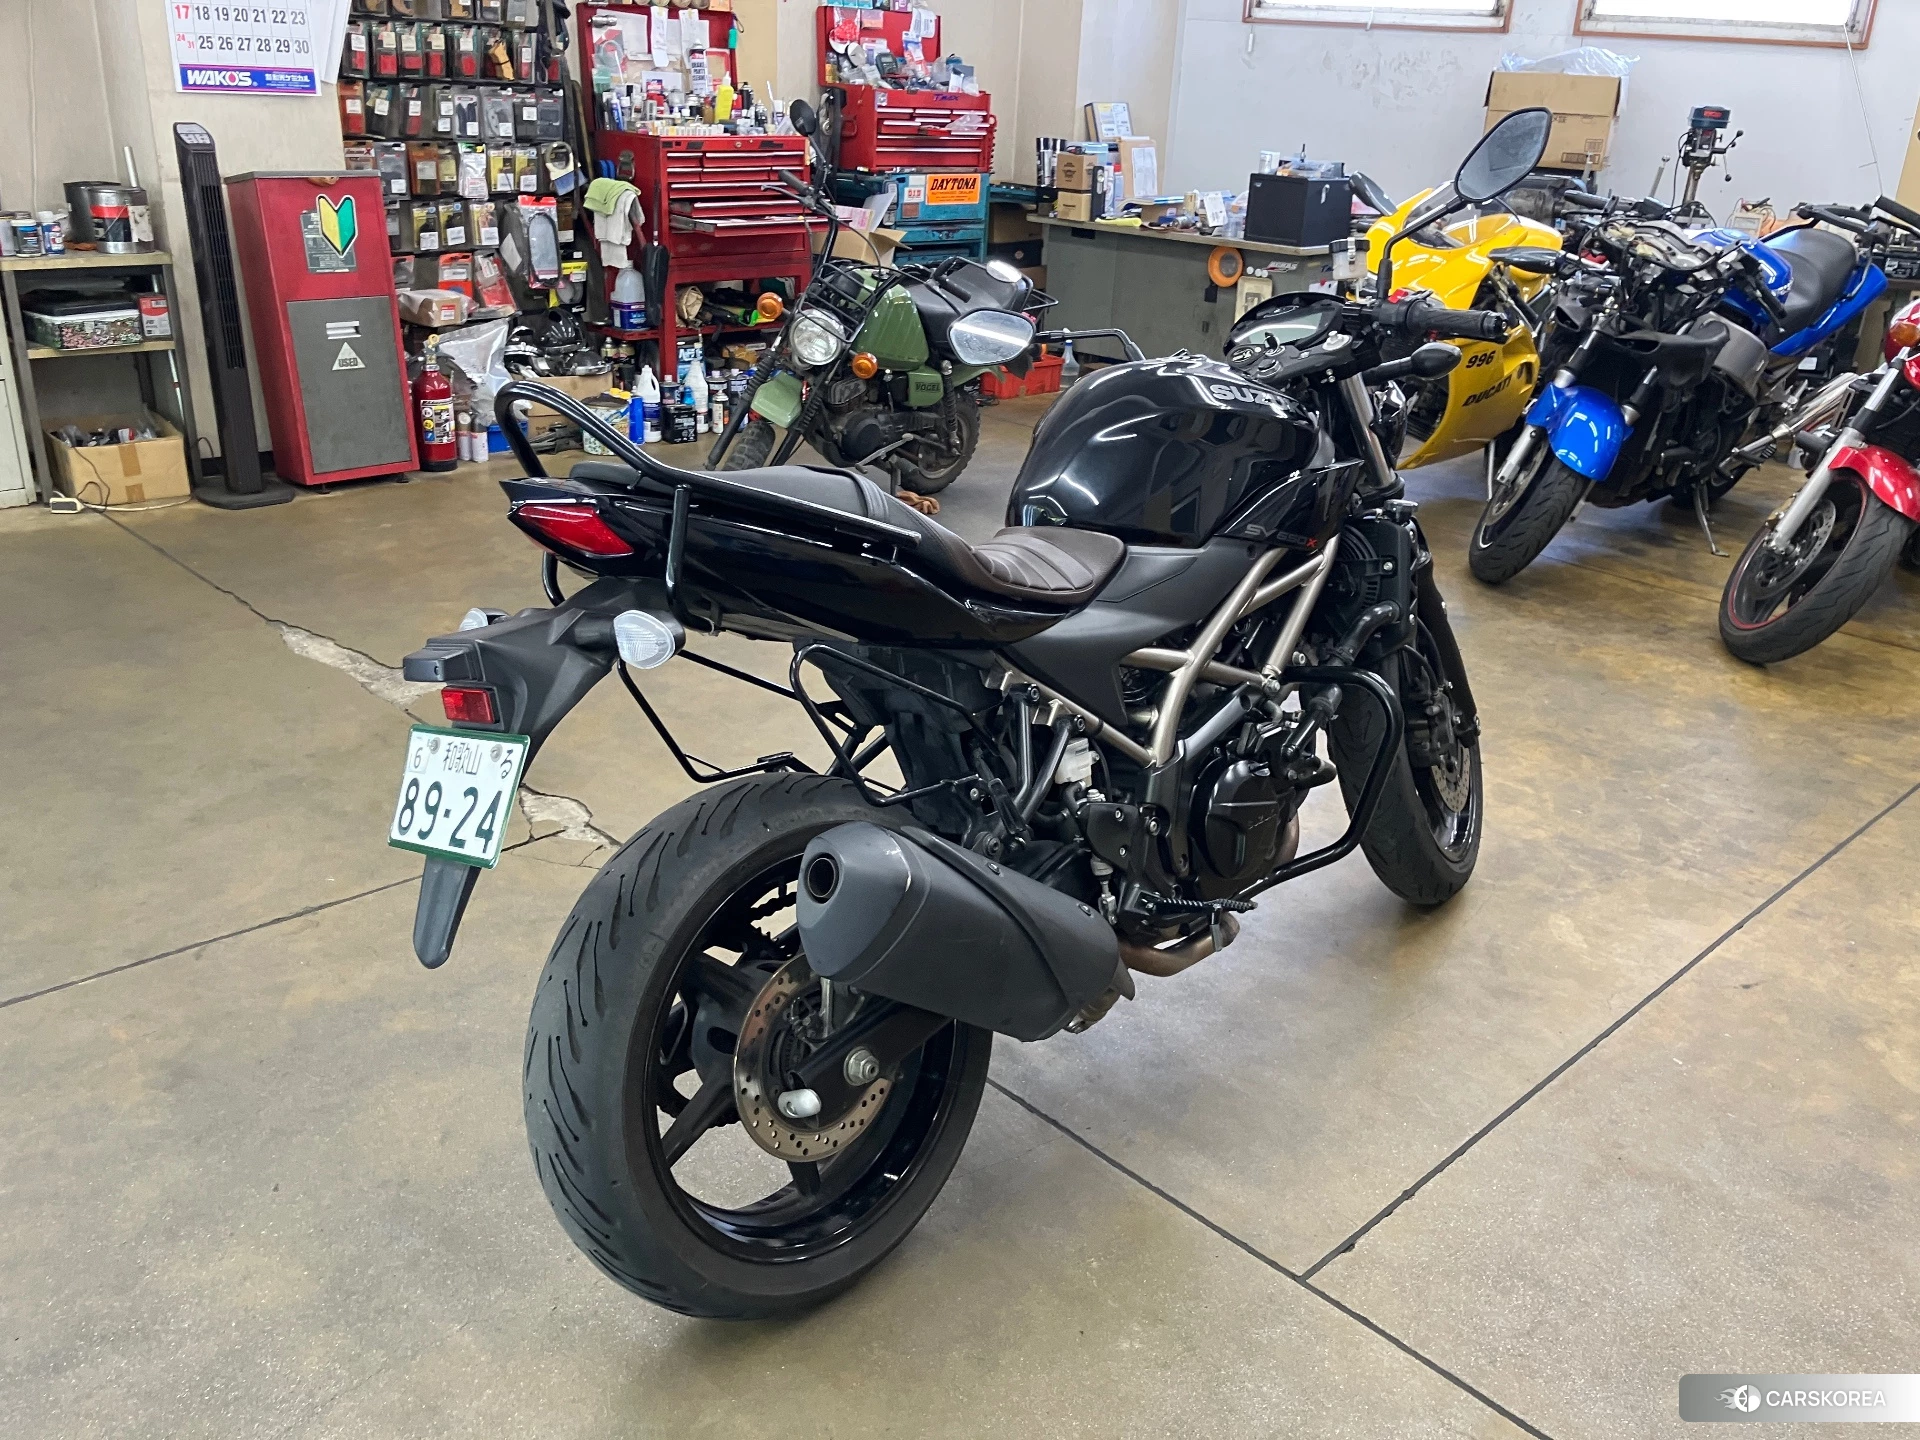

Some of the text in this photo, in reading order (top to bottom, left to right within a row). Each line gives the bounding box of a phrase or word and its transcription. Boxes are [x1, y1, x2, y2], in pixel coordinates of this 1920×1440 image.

[174, 5, 306, 26] 17 18 19 20 21 22 23
[177, 33, 186, 42] 24
[187, 41, 195, 49] 31
[199, 35, 310, 54] 25 26 27 28 29 30
[930, 178, 977, 191] DAYTONA
[1465, 350, 1496, 369] 996
[1462, 374, 1513, 407] DUCATI
[443, 741, 483, 776] 和歌山
